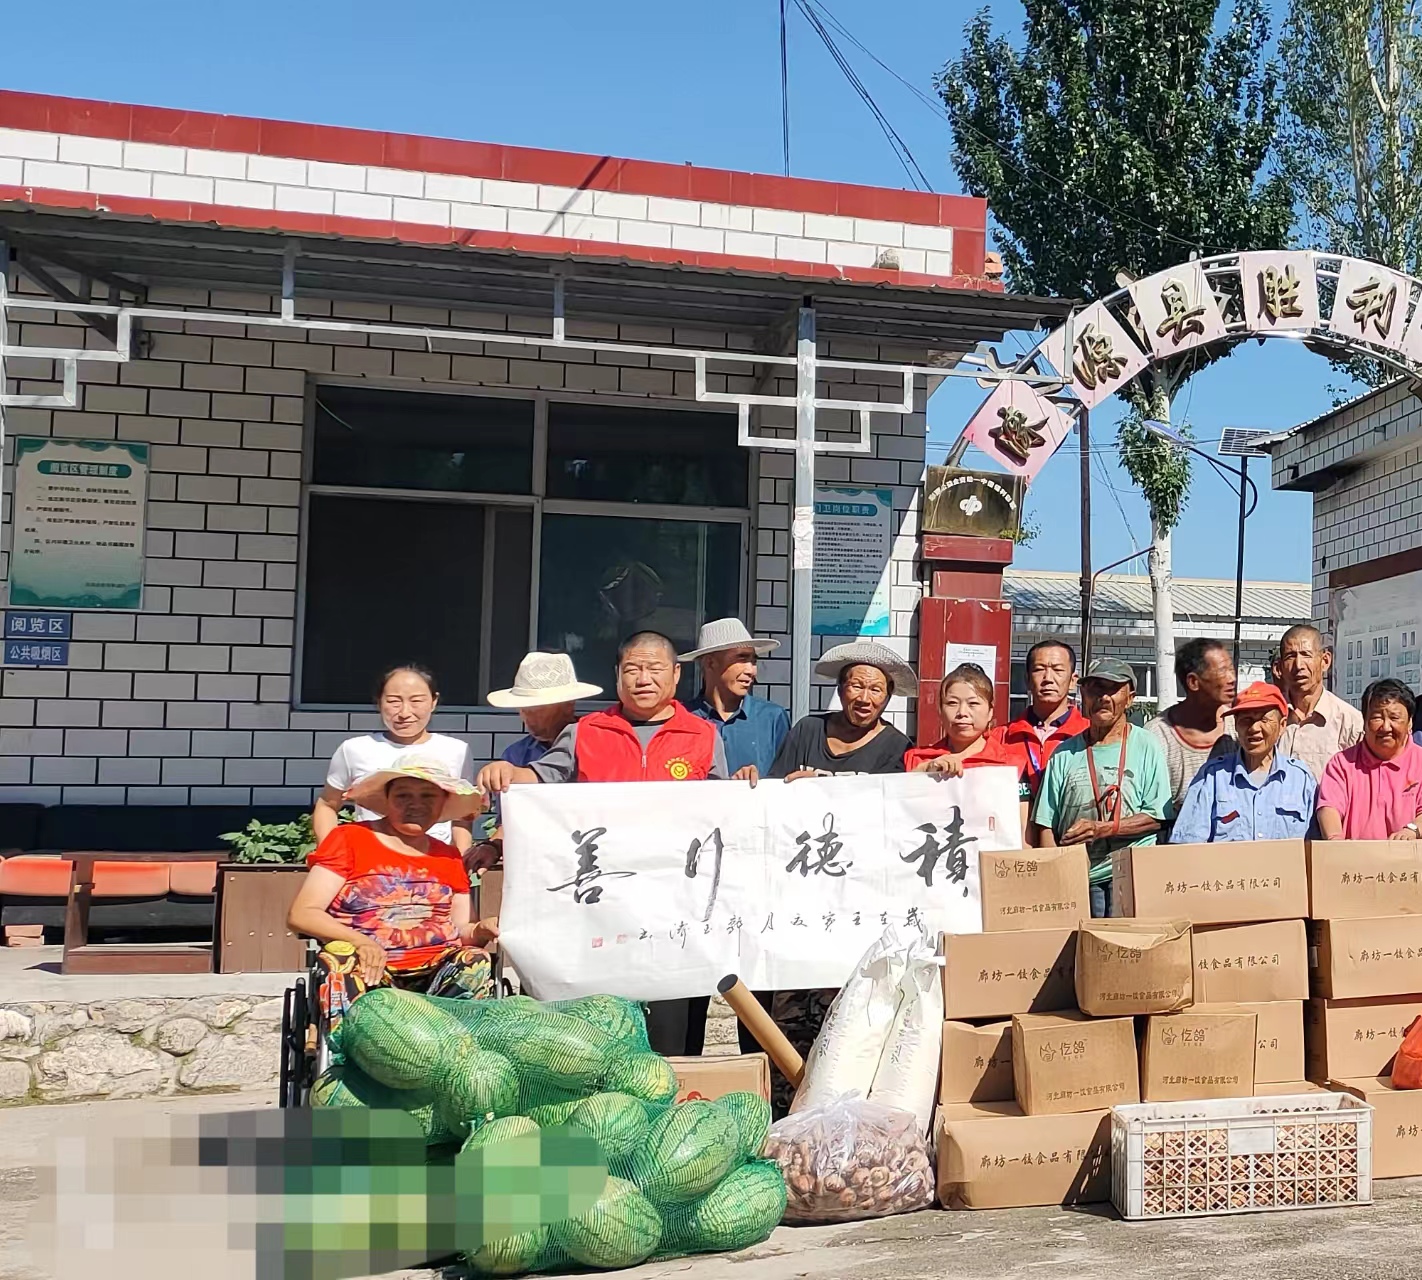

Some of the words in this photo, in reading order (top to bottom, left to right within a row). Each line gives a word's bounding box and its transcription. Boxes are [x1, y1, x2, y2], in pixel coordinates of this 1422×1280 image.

[11, 616, 64, 634] 阅览区
[10, 644, 62, 662] 公共吸烟区
[1257, 1038, 1279, 1050] 公司
